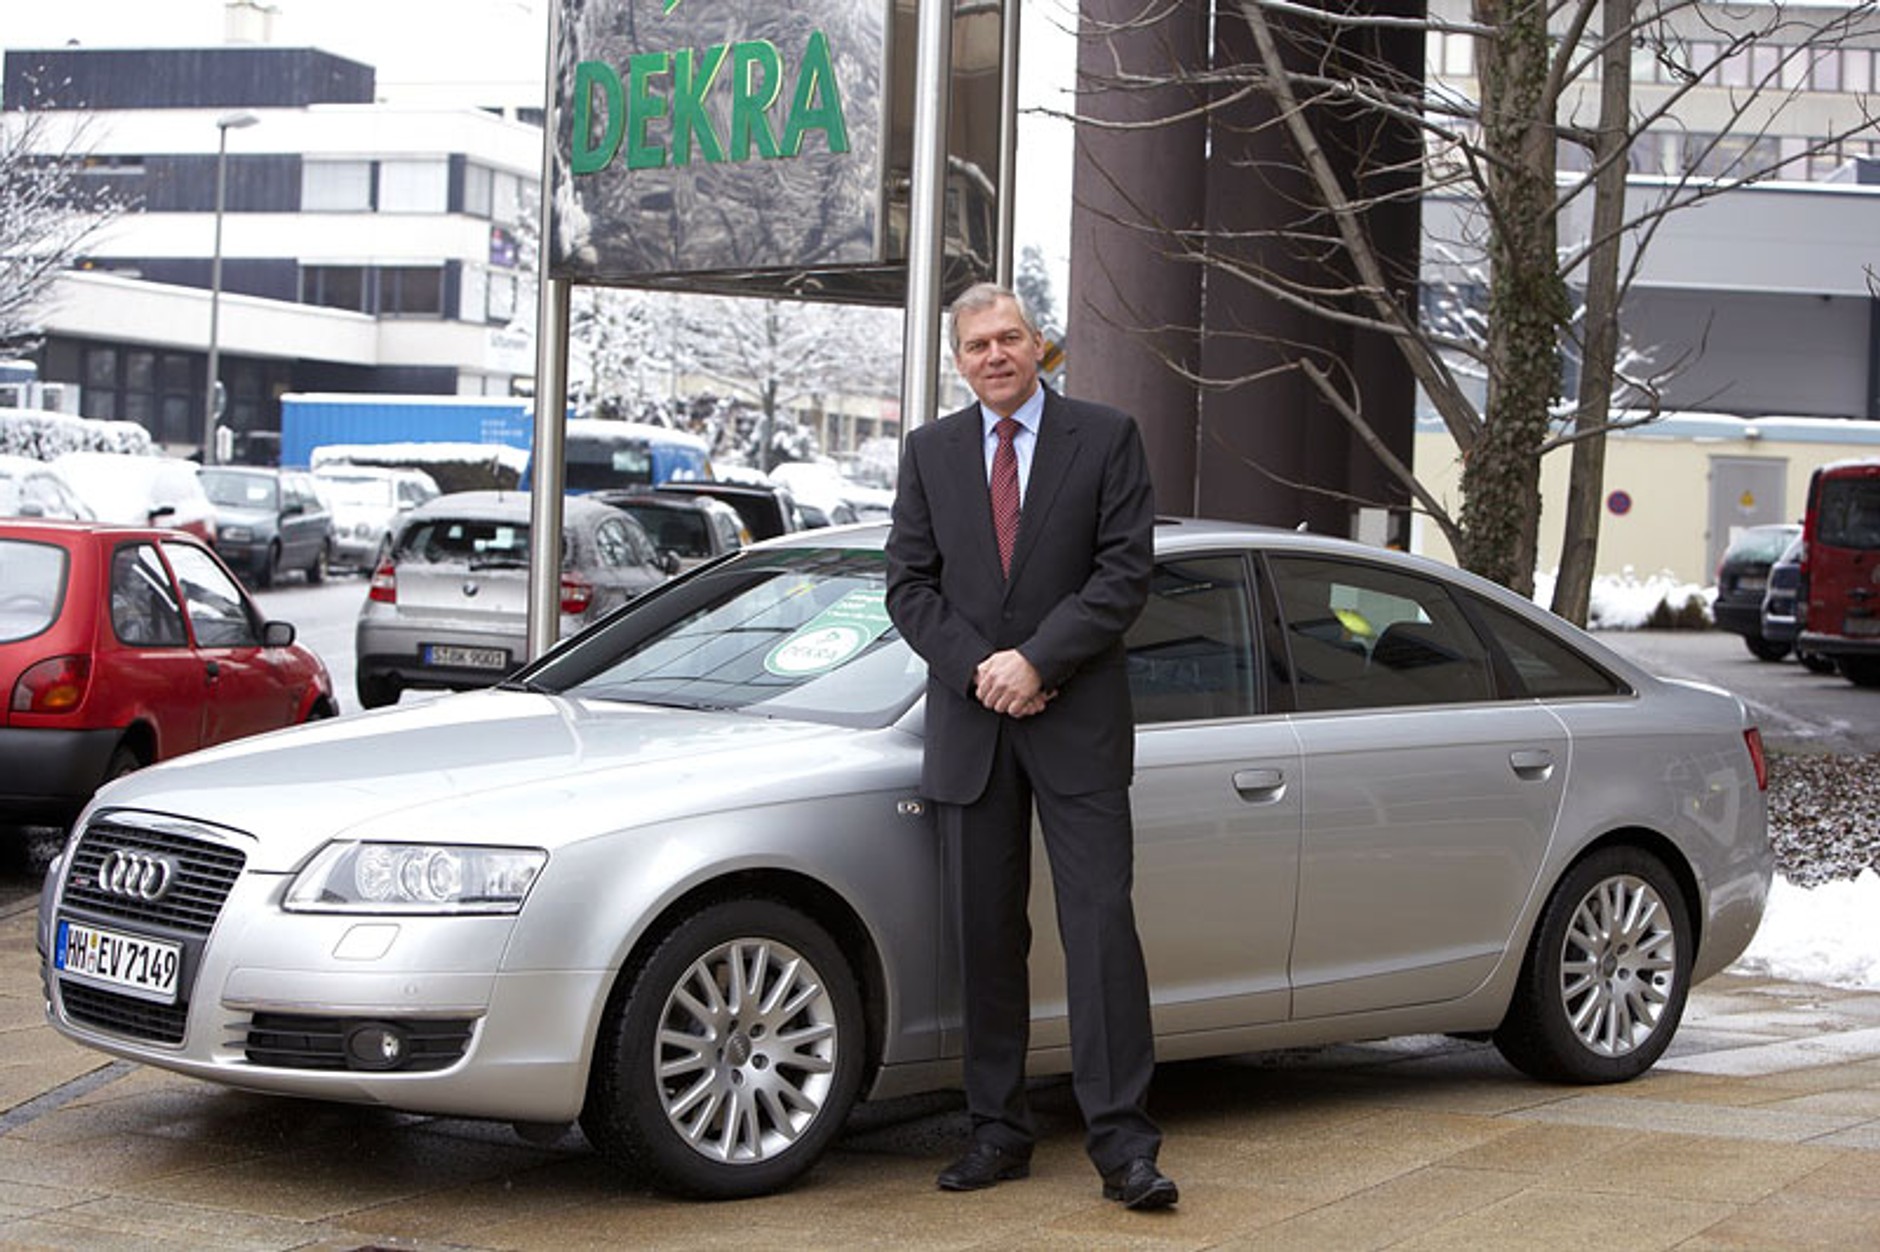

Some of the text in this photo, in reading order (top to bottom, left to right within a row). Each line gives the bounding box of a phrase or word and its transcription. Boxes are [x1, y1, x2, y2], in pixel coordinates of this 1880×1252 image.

[571, 30, 850, 174] DEKRA
[66, 929, 177, 988] HH EV 7149
